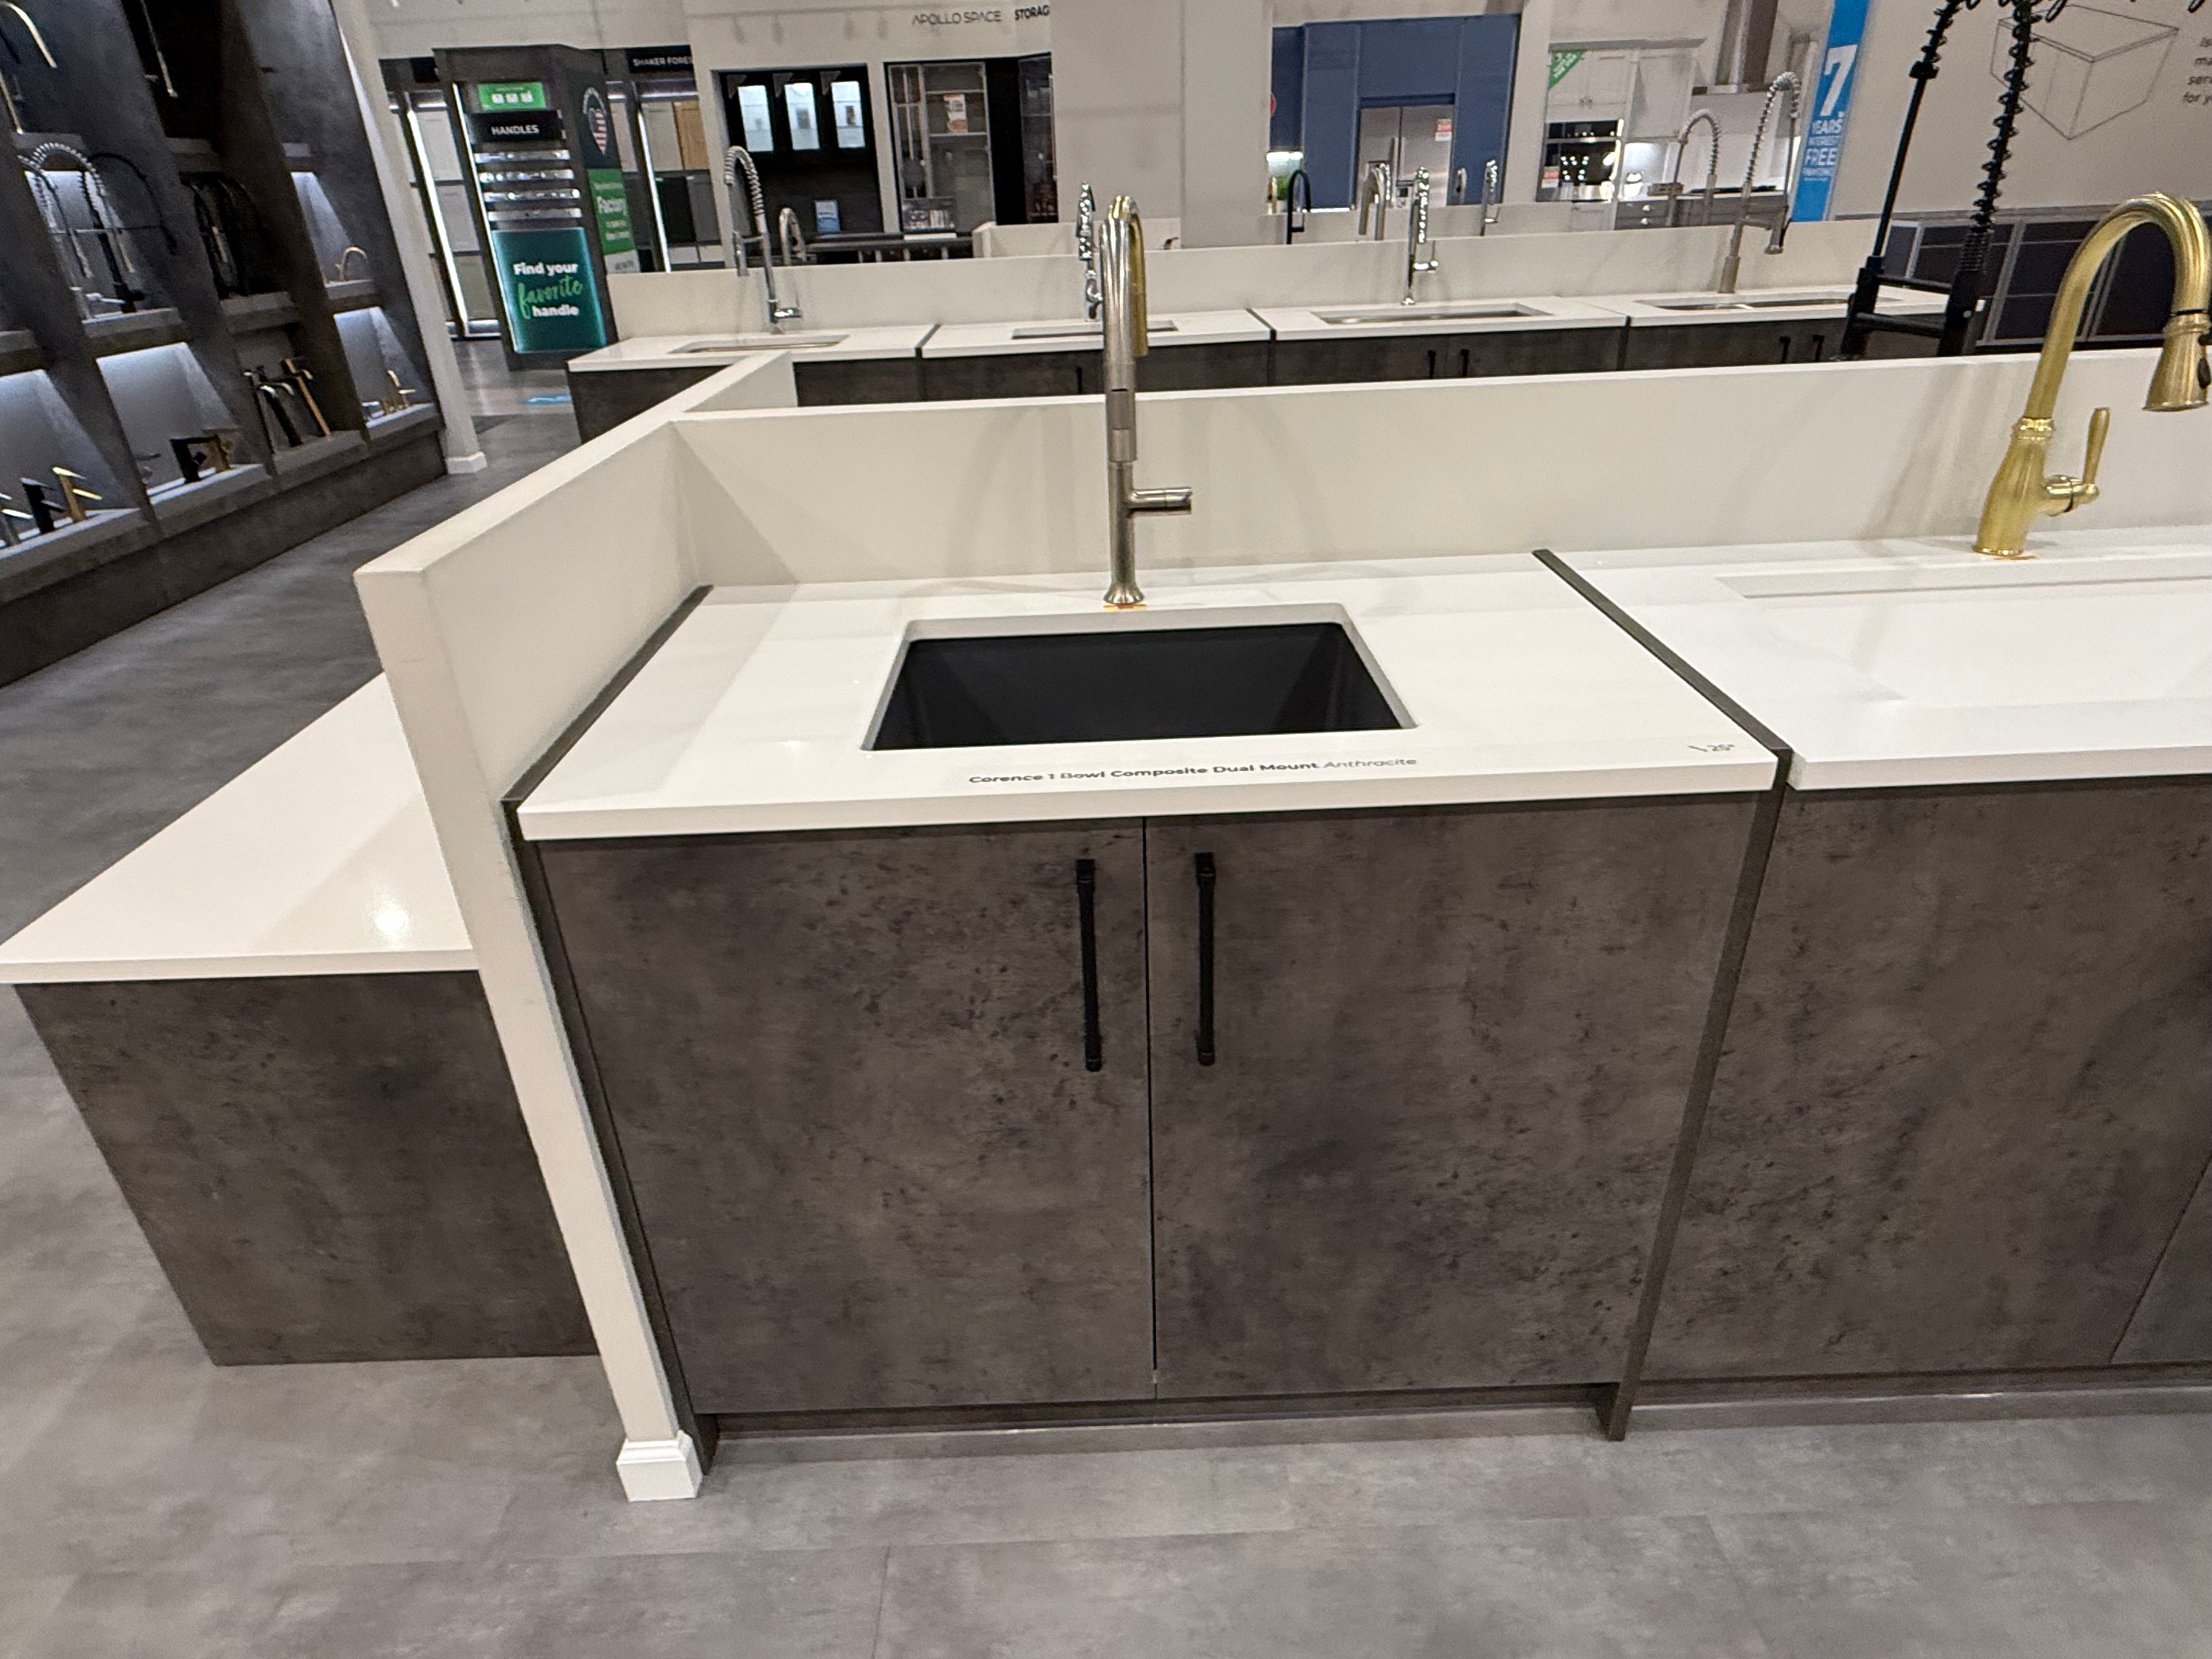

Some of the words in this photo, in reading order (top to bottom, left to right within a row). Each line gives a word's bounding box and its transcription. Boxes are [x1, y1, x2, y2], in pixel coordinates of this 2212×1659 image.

[491, 124, 540, 135] HANDLES
[1805, 148, 1837, 166] FREE
[513, 262, 544, 275] Find
[546, 263, 578, 276] your
[532, 304, 579, 317] handle
[1110, 767, 1207, 777] Composite
[1260, 763, 1319, 771] Mount
[1323, 758, 1417, 768] Anthracite
